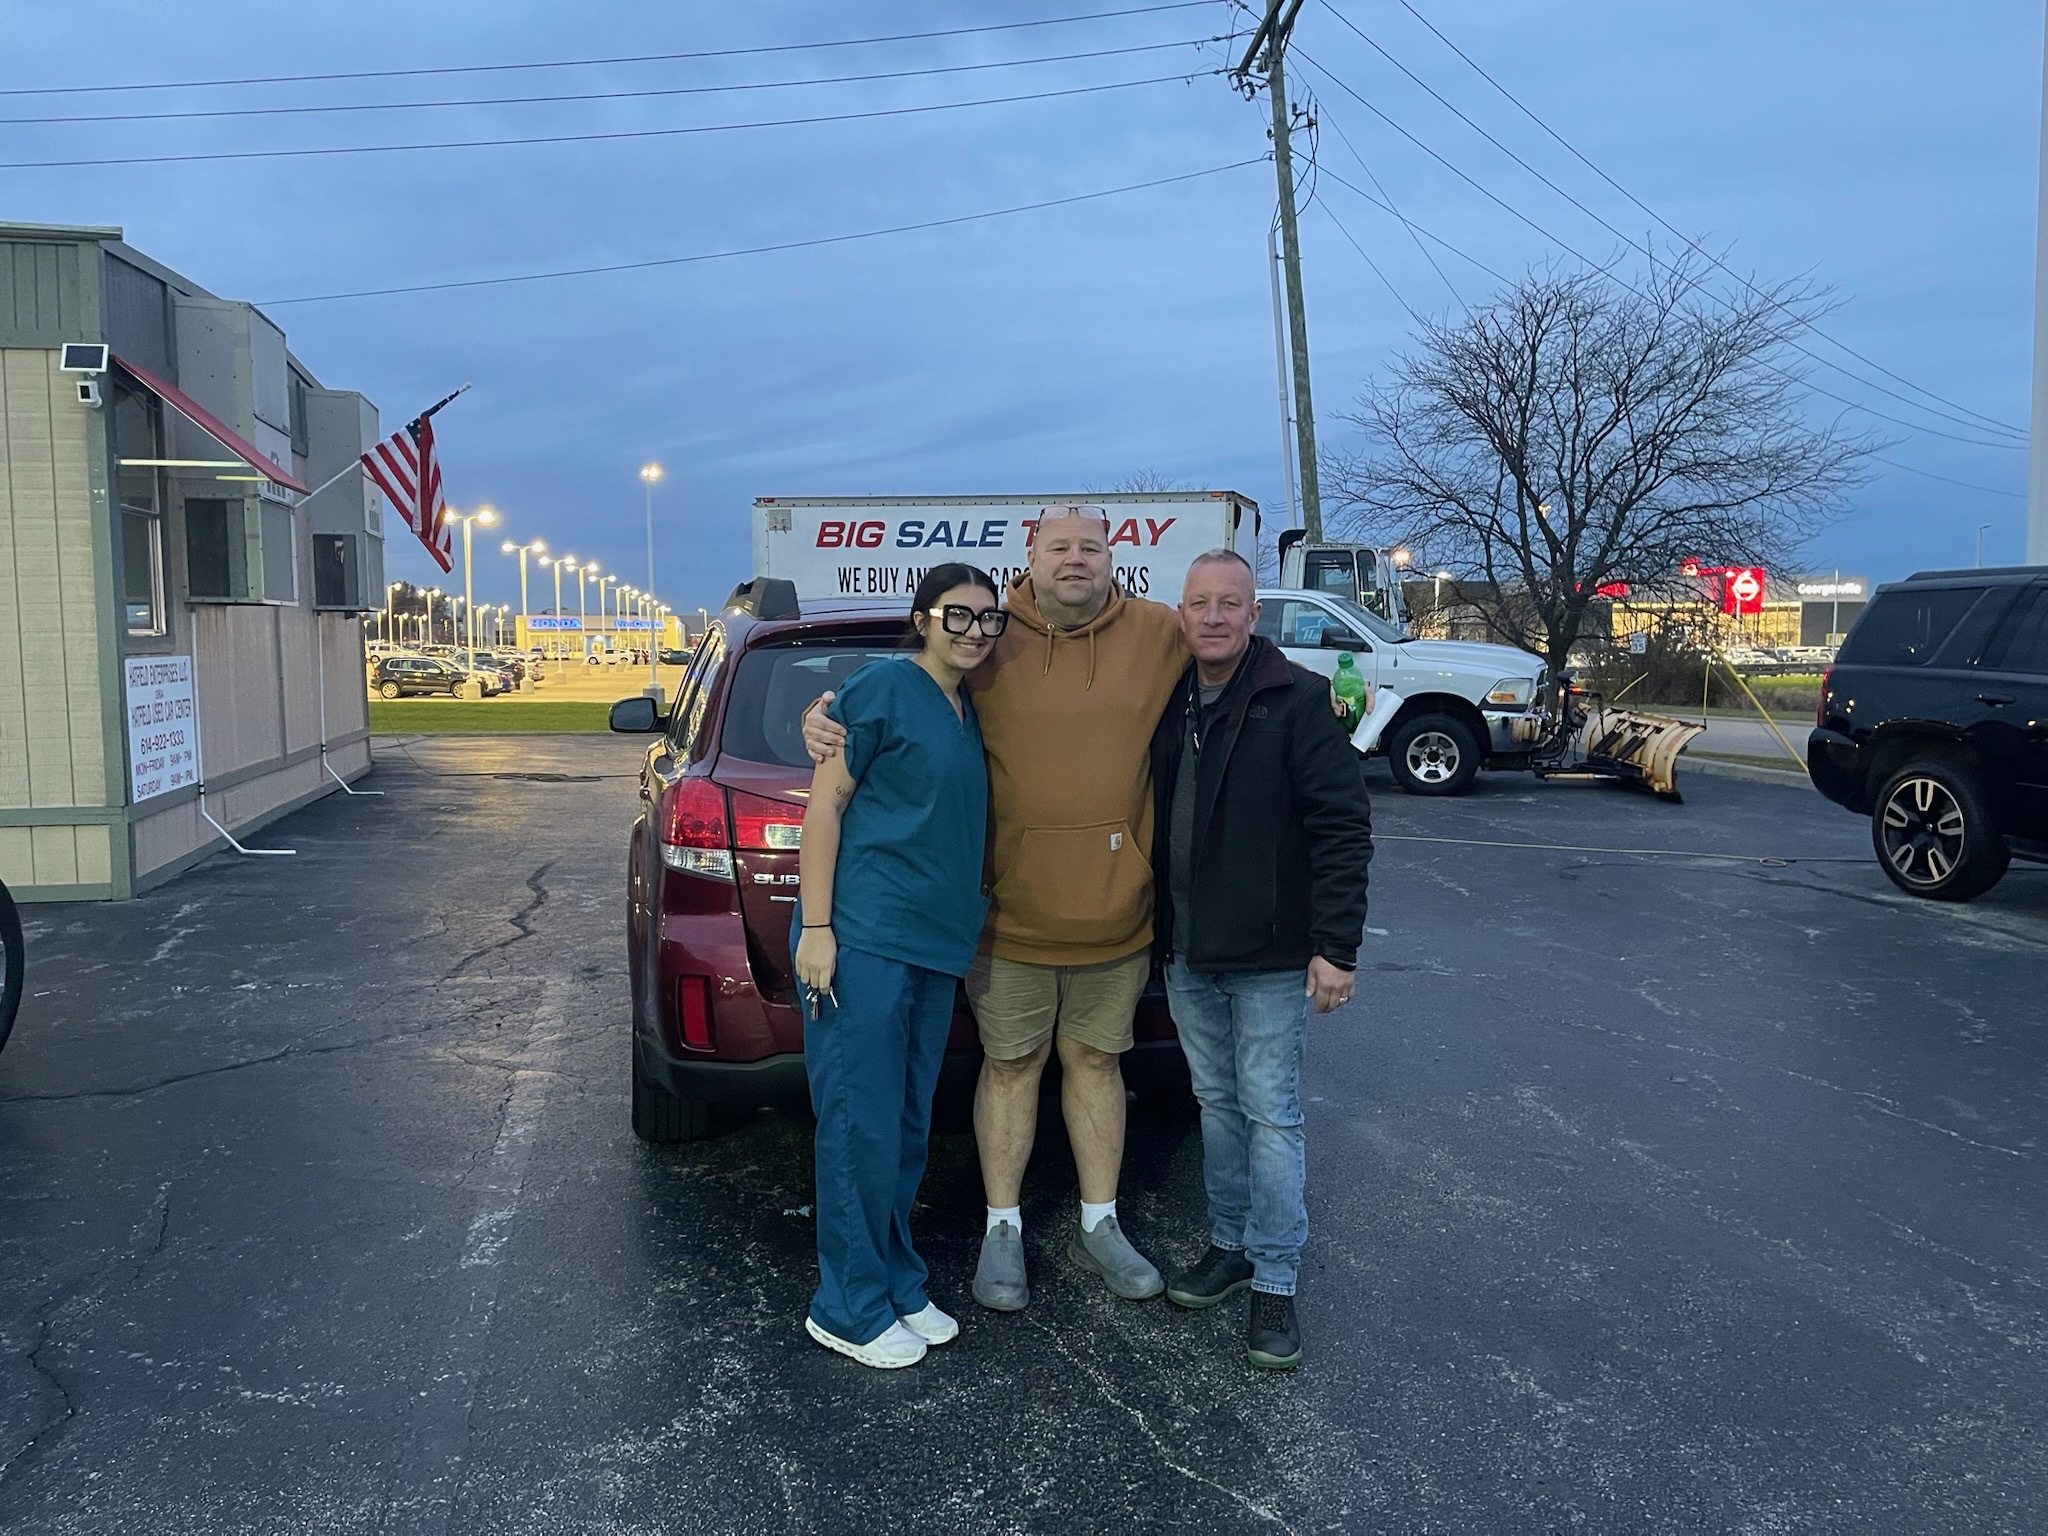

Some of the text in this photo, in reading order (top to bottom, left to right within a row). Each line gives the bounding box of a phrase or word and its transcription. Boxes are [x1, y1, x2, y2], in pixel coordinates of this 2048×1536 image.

[815, 518, 1178, 548] BIG SALE TAY
[837, 567, 862, 593] WE
[868, 567, 900, 593] BUY
[905, 567, 932, 593] AN
[990, 567, 1031, 593] CA
[530, 618, 582, 628] HONDA
[166, 701, 174, 721] CAR
[141, 730, 184, 755] 614-922-1333
[136, 757, 165, 777] MON-FRIDAY
[137, 779, 162, 798] SATURDAY
[753, 873, 800, 885] SUB
